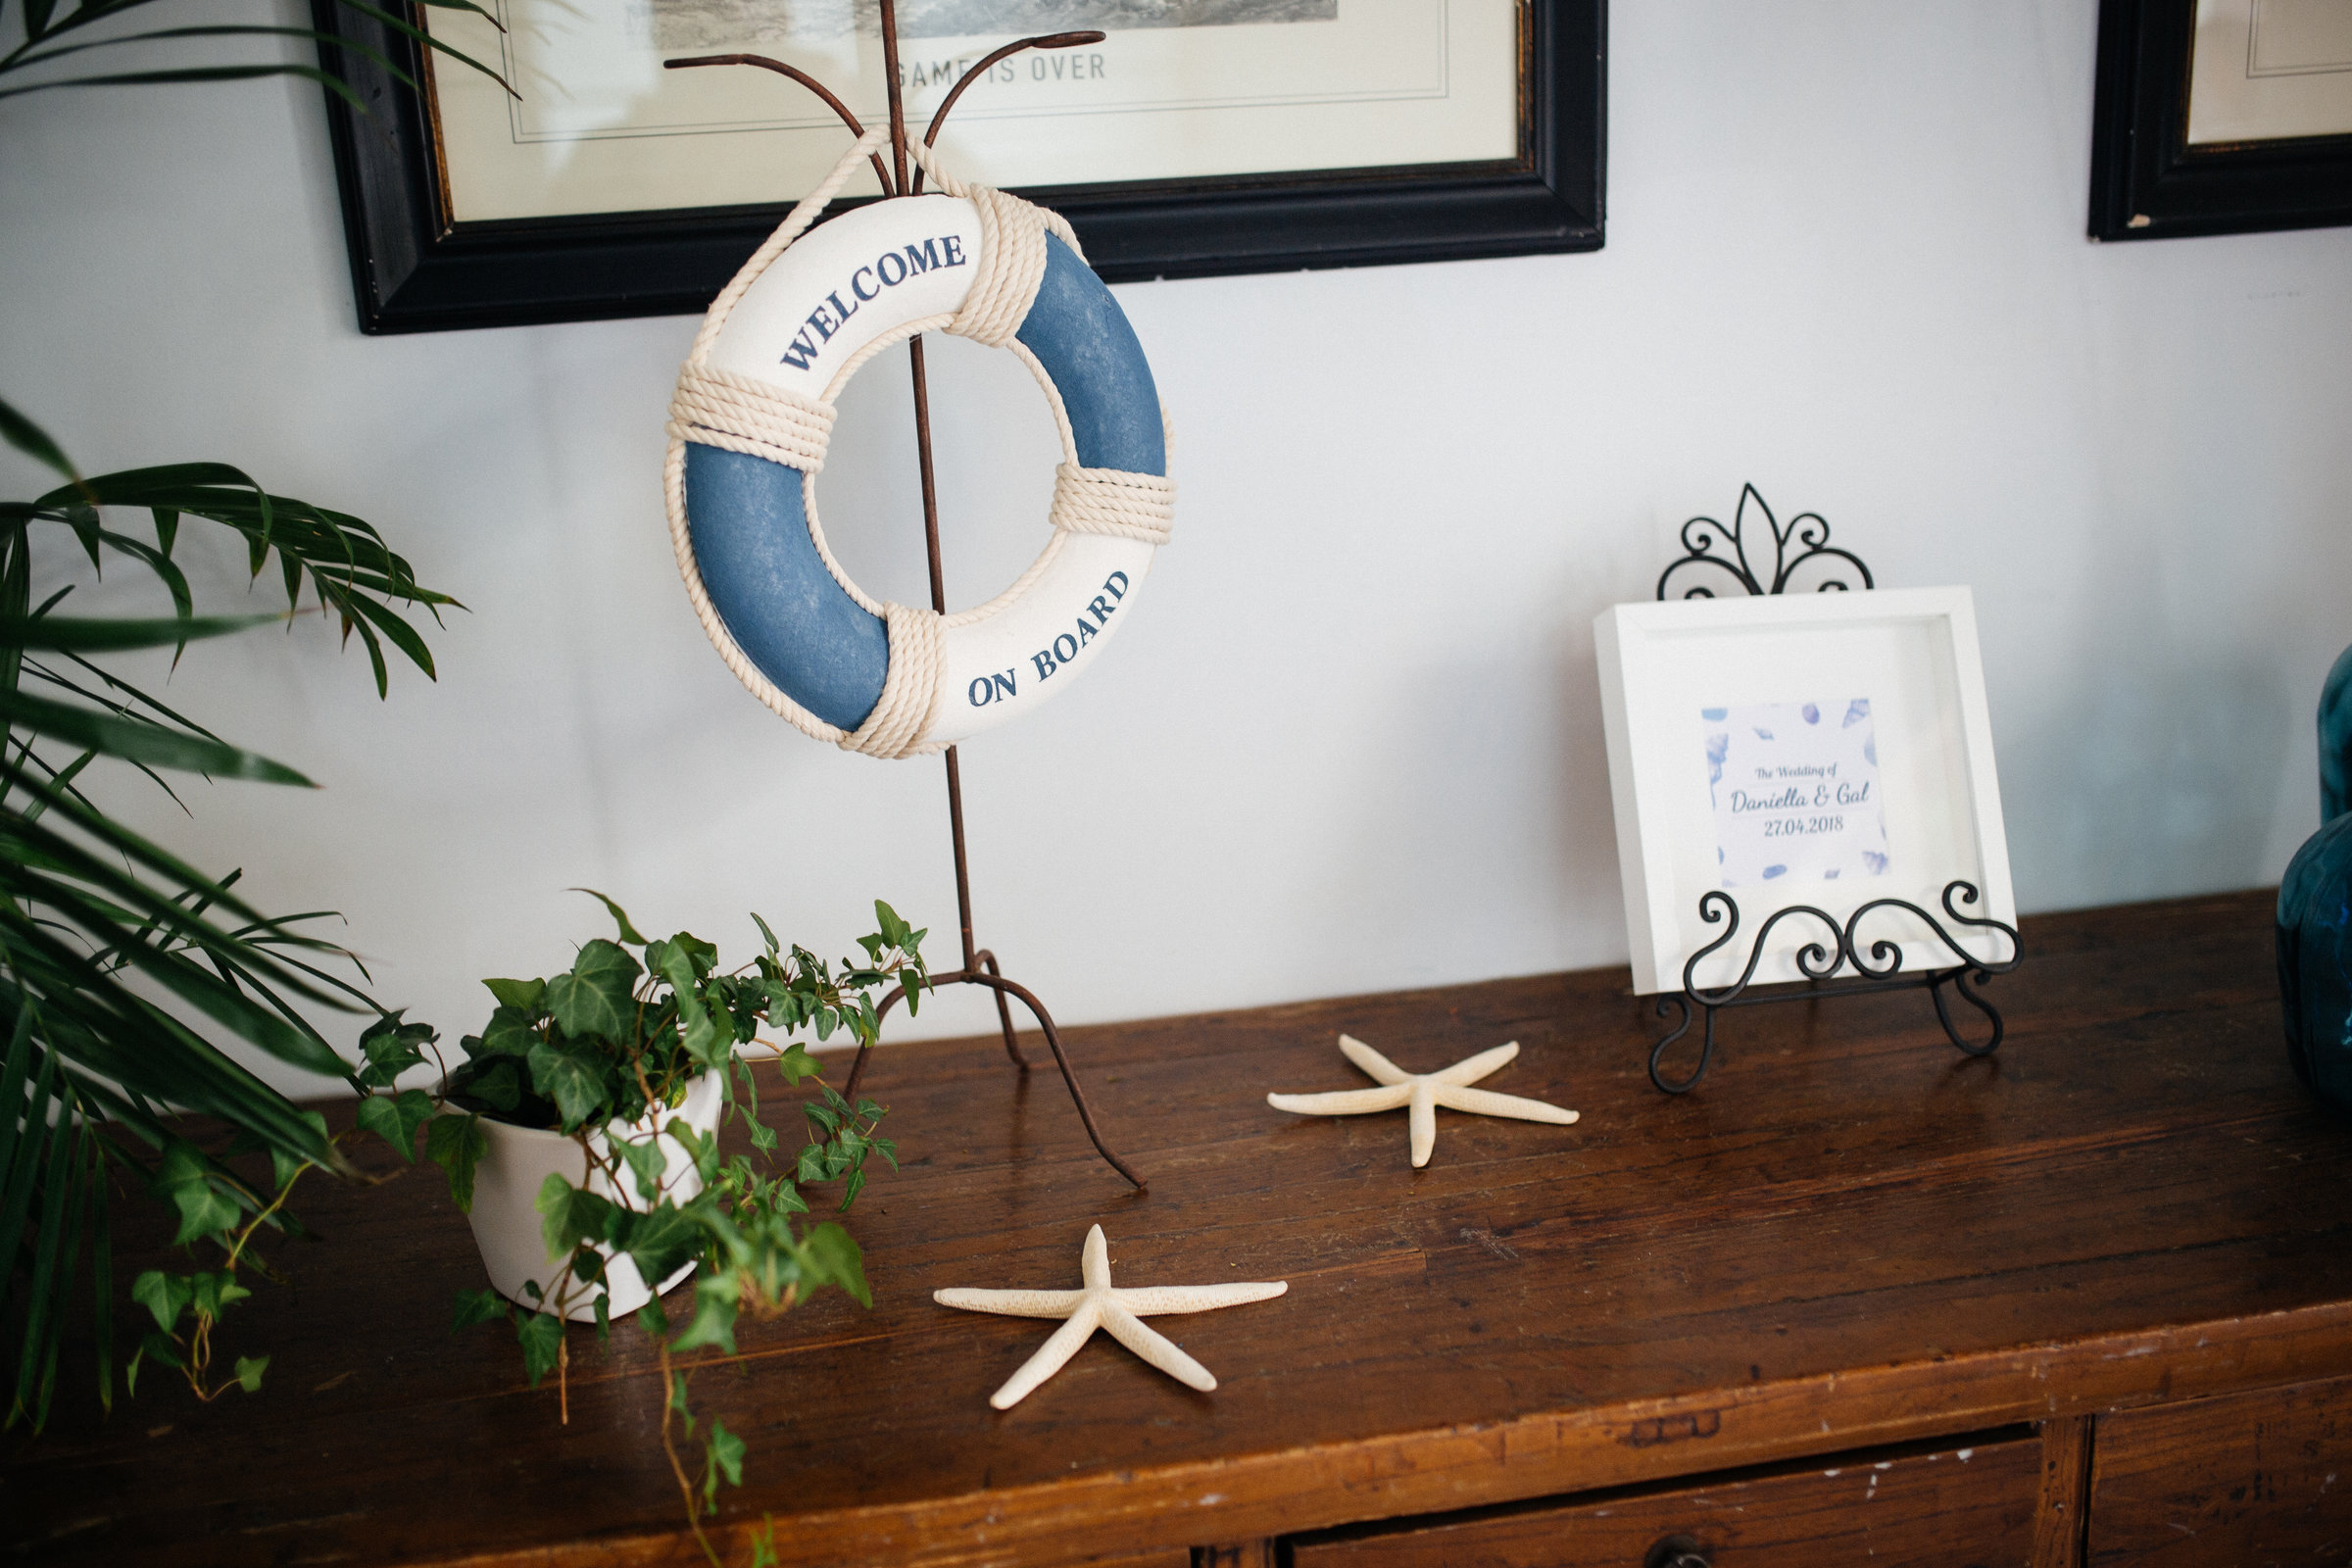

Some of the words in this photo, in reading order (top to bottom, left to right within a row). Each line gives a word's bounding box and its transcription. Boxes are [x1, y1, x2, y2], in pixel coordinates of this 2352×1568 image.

[989, 57, 1014, 83] IS
[1032, 53, 1105, 81] OVER
[780, 234, 967, 375] WELCOME
[967, 668, 1017, 709] ON
[1030, 569, 1130, 683] BOARD
[1755, 767, 1773, 779] The
[1776, 764, 1825, 778] Wedding
[1827, 761, 1837, 777] of
[1731, 786, 1808, 813] Daniella
[1813, 783, 1830, 808] &
[1837, 780, 1870, 807] Gal
[1764, 814, 1843, 837] 27.04.2018
